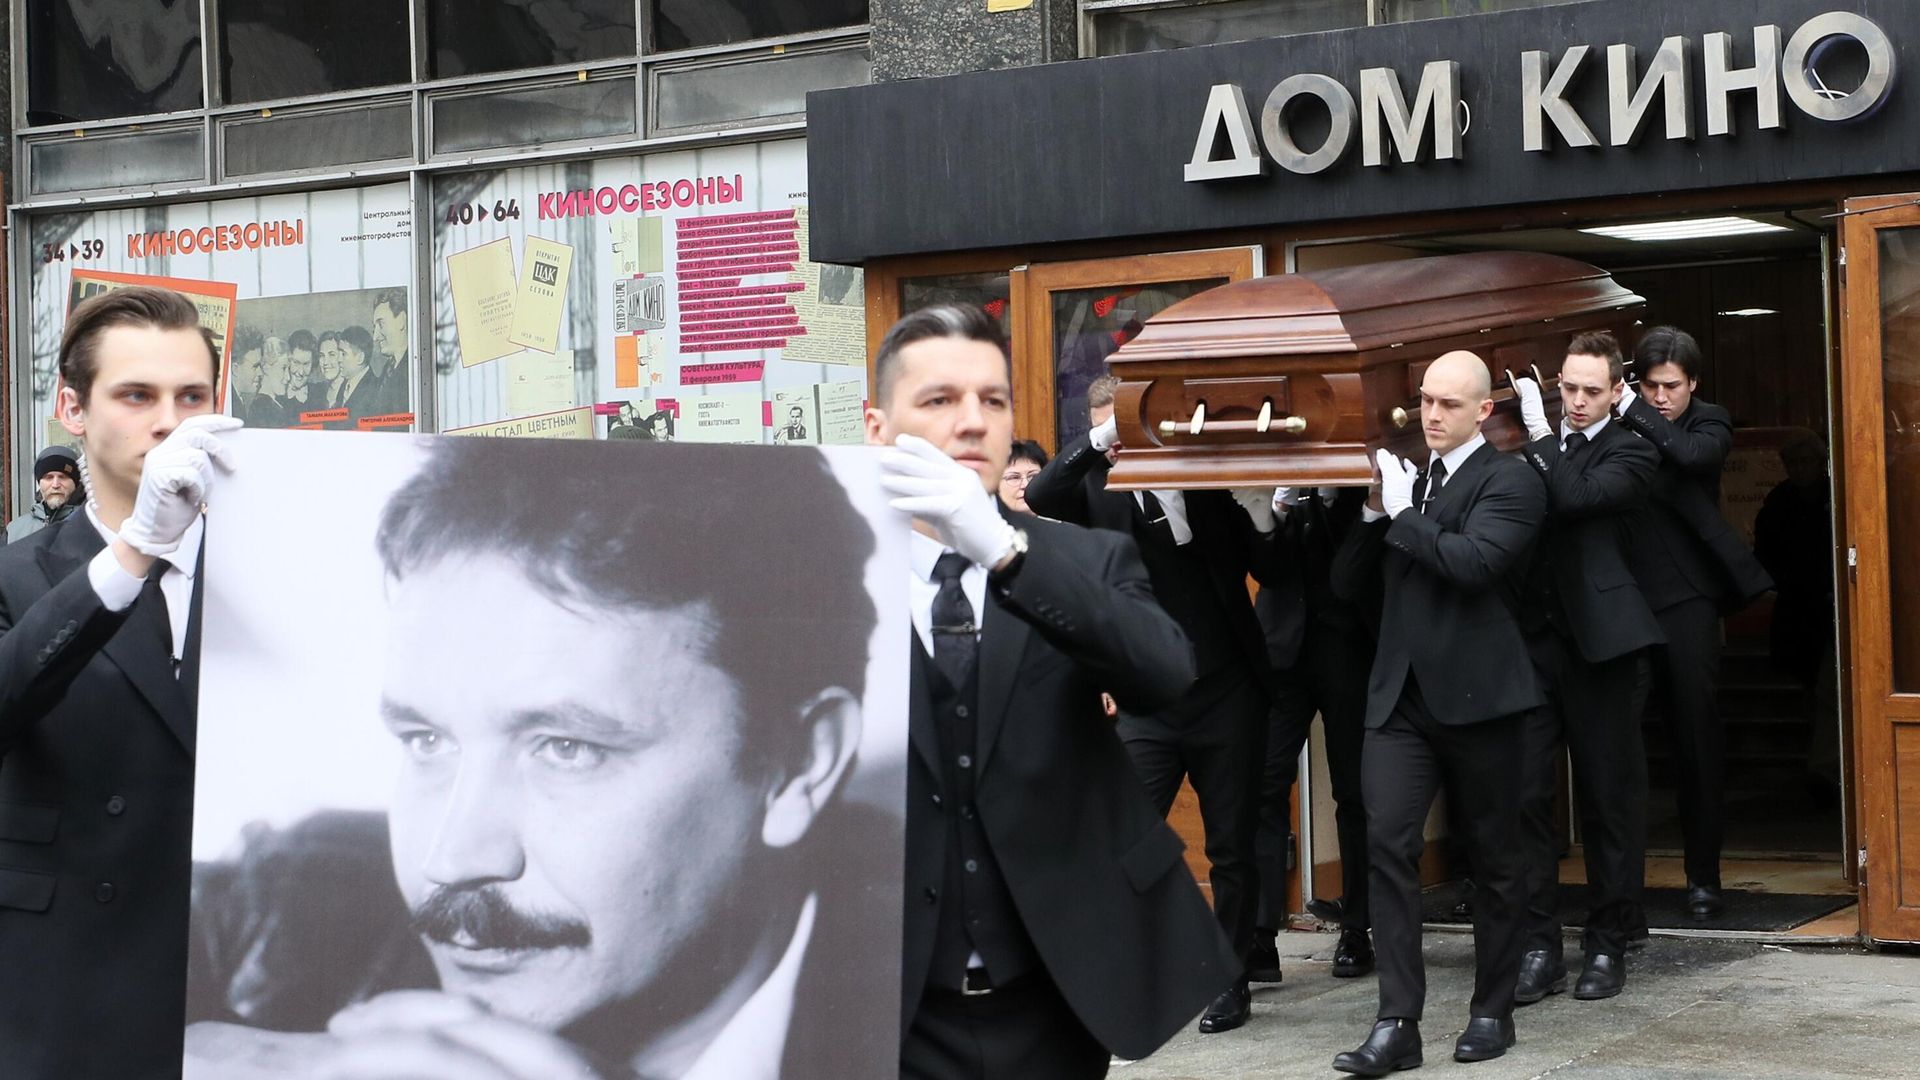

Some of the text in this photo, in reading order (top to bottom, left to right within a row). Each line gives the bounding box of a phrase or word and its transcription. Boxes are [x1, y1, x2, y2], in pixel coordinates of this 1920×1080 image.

[1184, 11, 1894, 181] ДОМ КИНО
[538, 173, 743, 220] КИНОСЕЗОНЫ
[363, 207, 411, 219] Центральный
[446, 199, 520, 225] 40 64
[687, 217, 718, 228] февраля
[724, 212, 774, 224] Центральном
[127, 218, 304, 260] КИНОСЕЗОНЫ
[341, 231, 411, 242] кинематографистов
[698, 227, 739, 237] состоялось
[679, 239, 713, 249] открытие
[715, 235, 770, 246] мемориальной
[42, 239, 104, 264] 34 39
[679, 249, 723, 260] работникам
[725, 245, 765, 256] фронтовых
[718, 257, 755, 267] погибшим
[680, 271, 709, 280] Великой
[711, 266, 767, 278] Отечественной
[735, 284, 777, 296] Александр
[643, 283, 665, 322] КИНО
[708, 311, 730, 320] перед
[731, 308, 761, 317] светлой
[725, 330, 757, 341] эпизоды
[710, 341, 752, 351] советского
[681, 364, 724, 373] СОВЕТСКАЯ
[689, 374, 721, 384] февраля
[494, 413, 577, 438] СТАЛ ЦВЕТНЫМ
